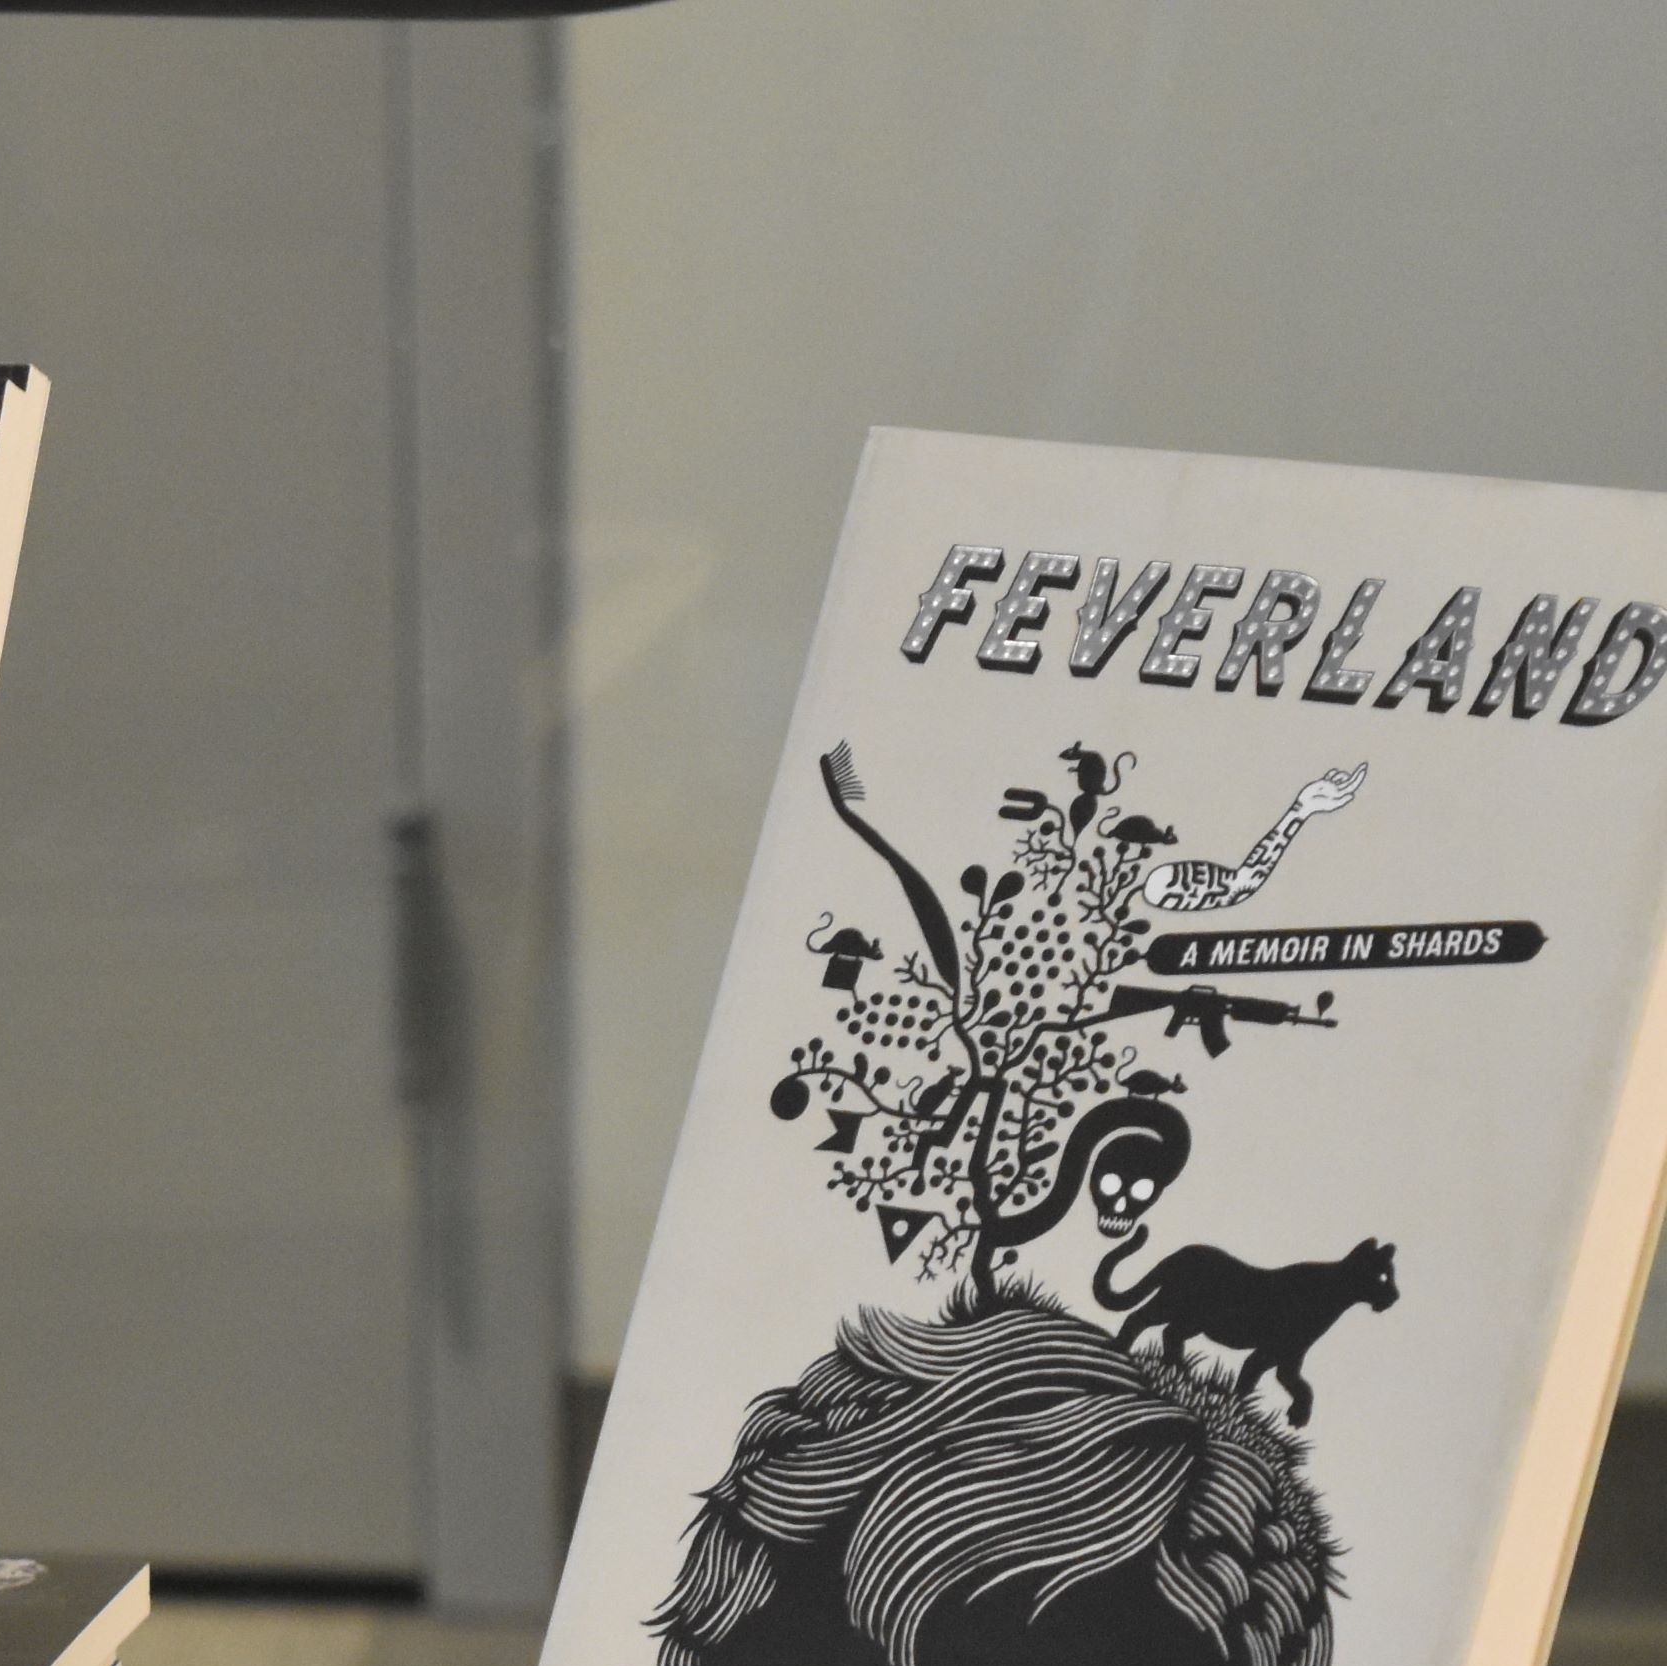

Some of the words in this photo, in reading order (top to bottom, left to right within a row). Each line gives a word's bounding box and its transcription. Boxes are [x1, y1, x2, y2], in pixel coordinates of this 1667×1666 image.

[900, 543, 1667, 727] FEVERLAND
[1178, 942, 1199, 968] A
[1208, 935, 1329, 967] MEMOIR
[1340, 931, 1373, 961] IN
[1387, 927, 1504, 960] SHARDS
